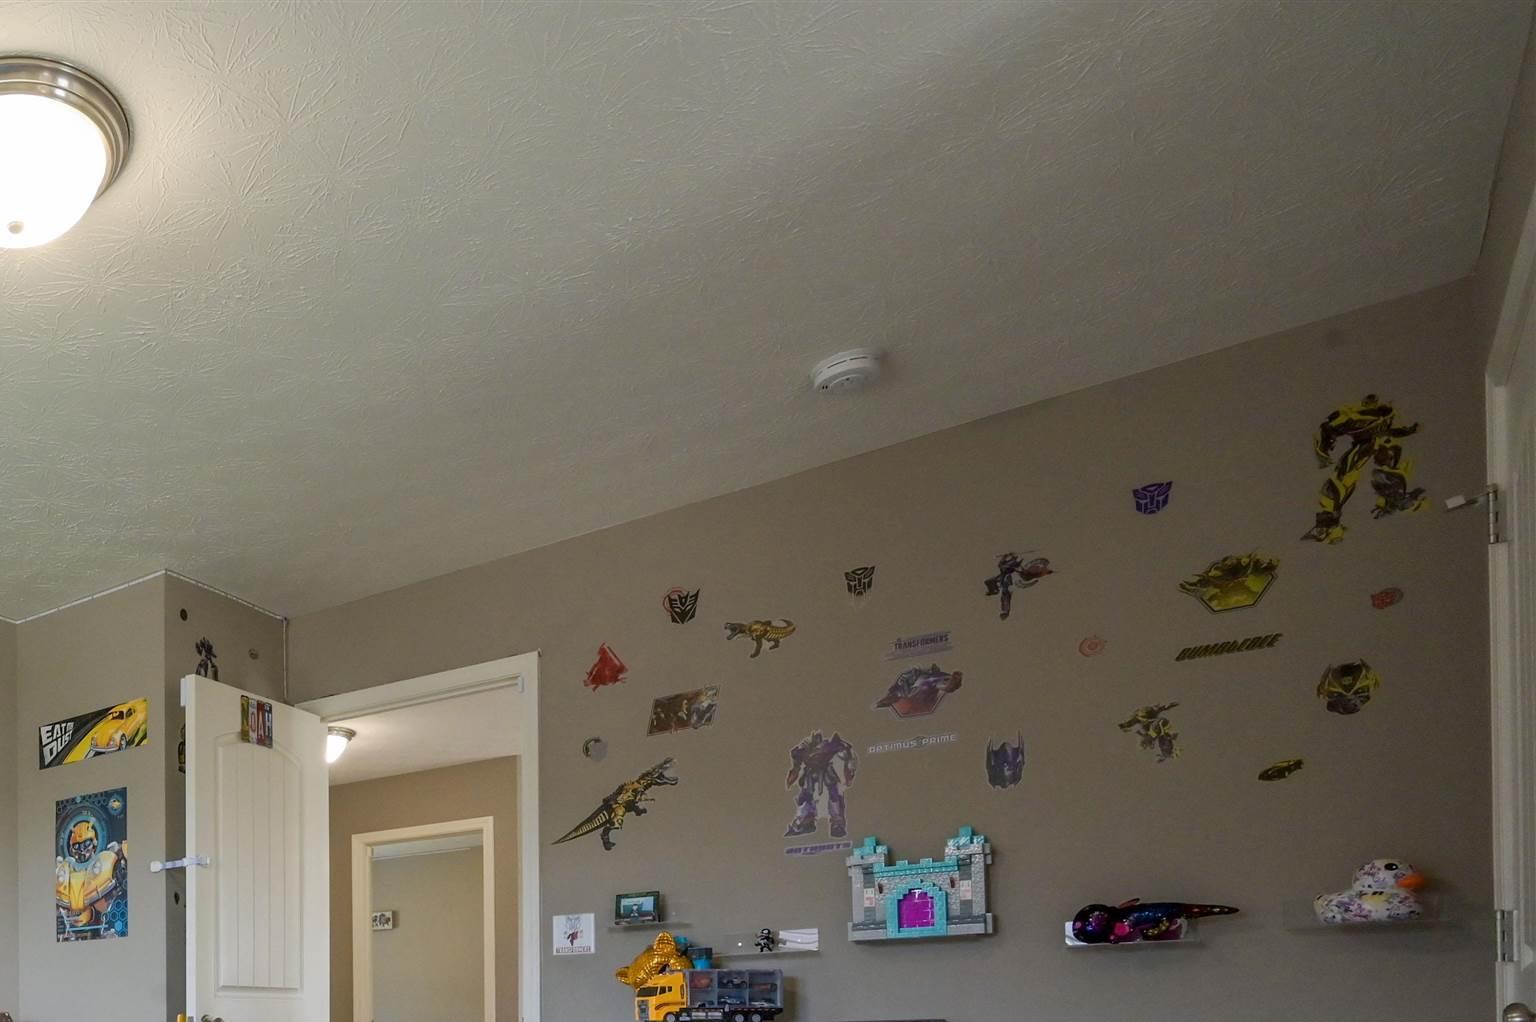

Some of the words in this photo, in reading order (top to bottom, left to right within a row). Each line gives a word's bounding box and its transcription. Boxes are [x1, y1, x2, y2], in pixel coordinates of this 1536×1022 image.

[40, 722, 67, 746] EAT
[869, 740, 918, 753] OPTIMUS
[922, 734, 957, 745] PRIME
[43, 731, 73, 766] DUST
